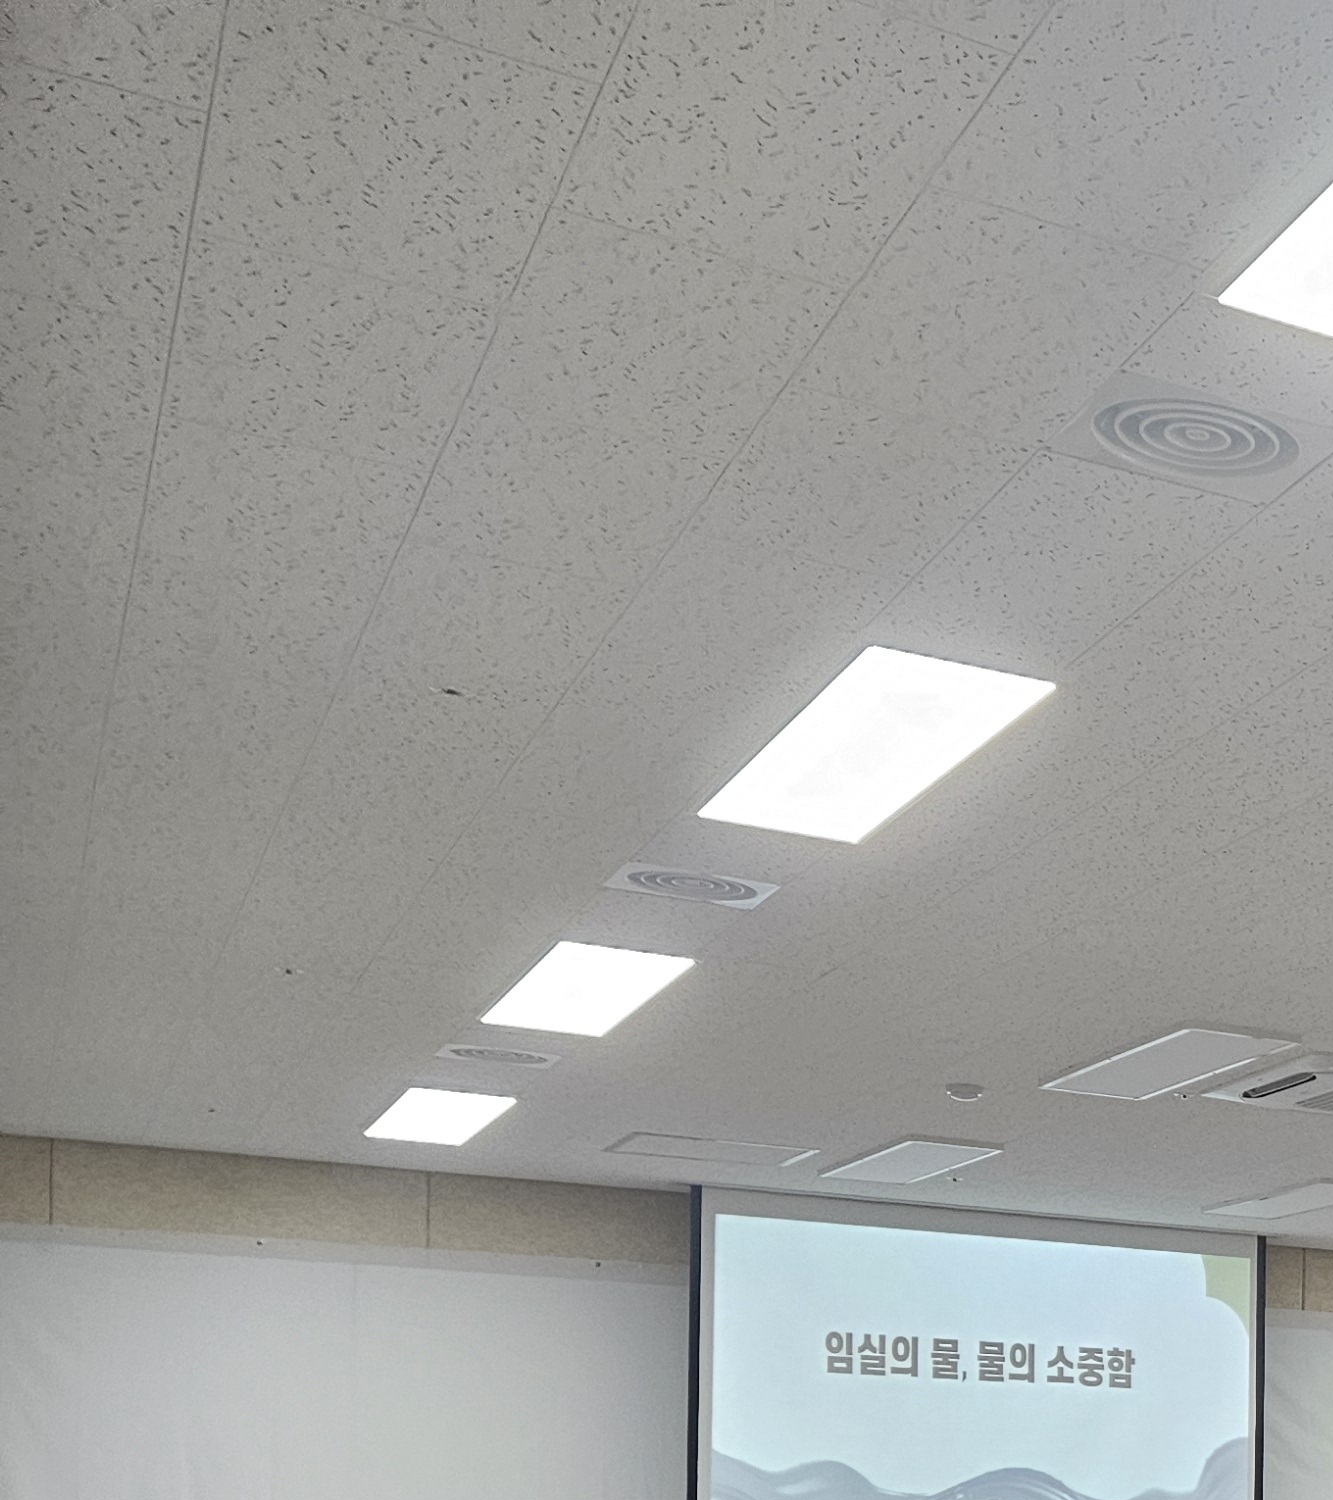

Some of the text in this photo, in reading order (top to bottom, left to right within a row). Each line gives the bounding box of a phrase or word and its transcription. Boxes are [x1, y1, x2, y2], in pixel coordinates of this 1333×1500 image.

[825, 1331, 1136, 1388] 임실의 물, 물의 소중함
